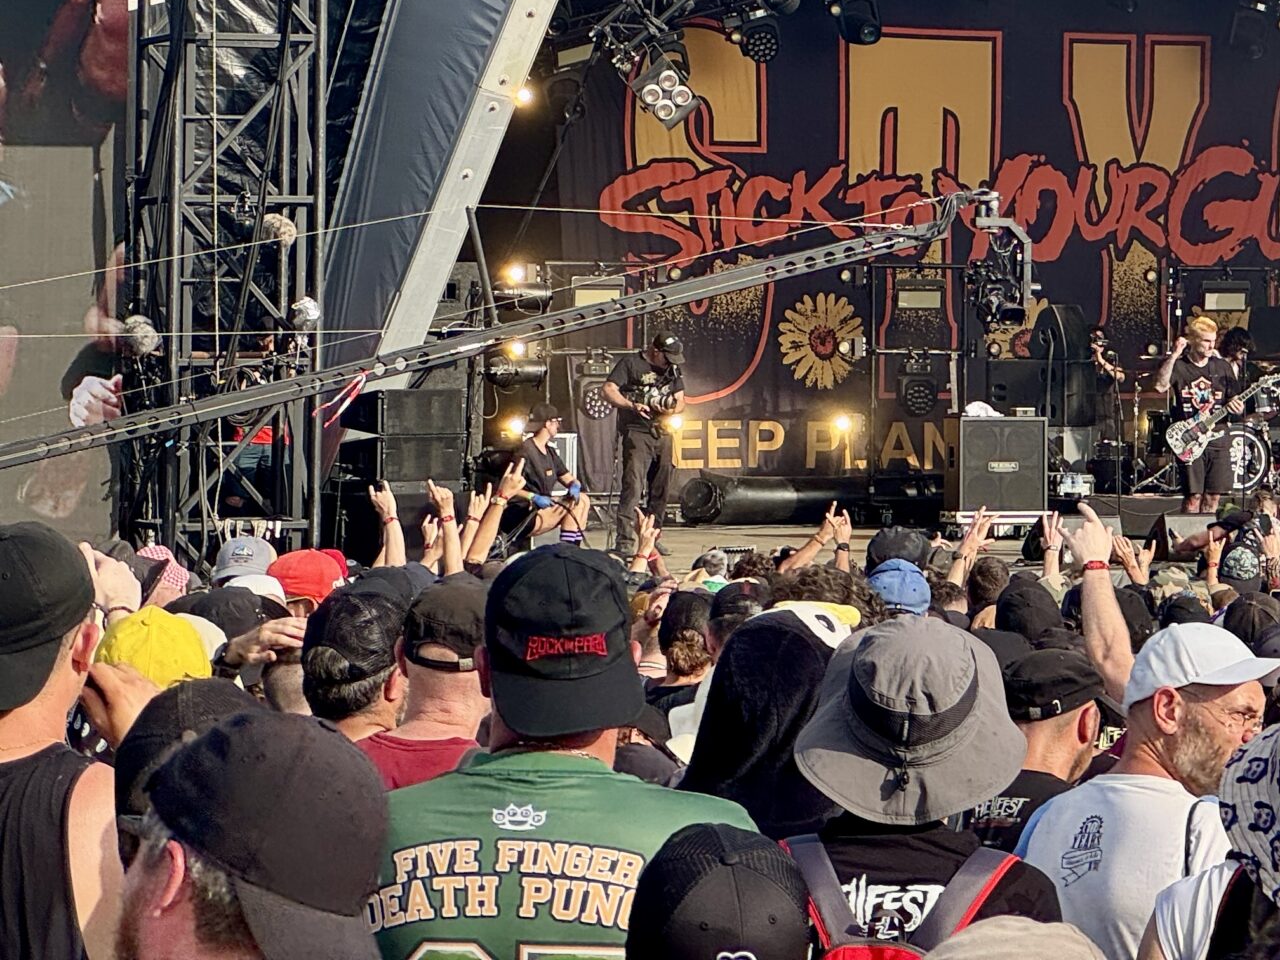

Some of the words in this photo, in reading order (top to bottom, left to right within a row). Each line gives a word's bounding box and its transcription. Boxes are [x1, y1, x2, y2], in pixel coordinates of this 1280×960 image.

[599, 159, 858, 271] STICK
[671, 419, 785, 470] EEP
[392, 839, 482, 884] FIVE
[494, 839, 646, 888] FINGER
[362, 875, 499, 934] DEATH
